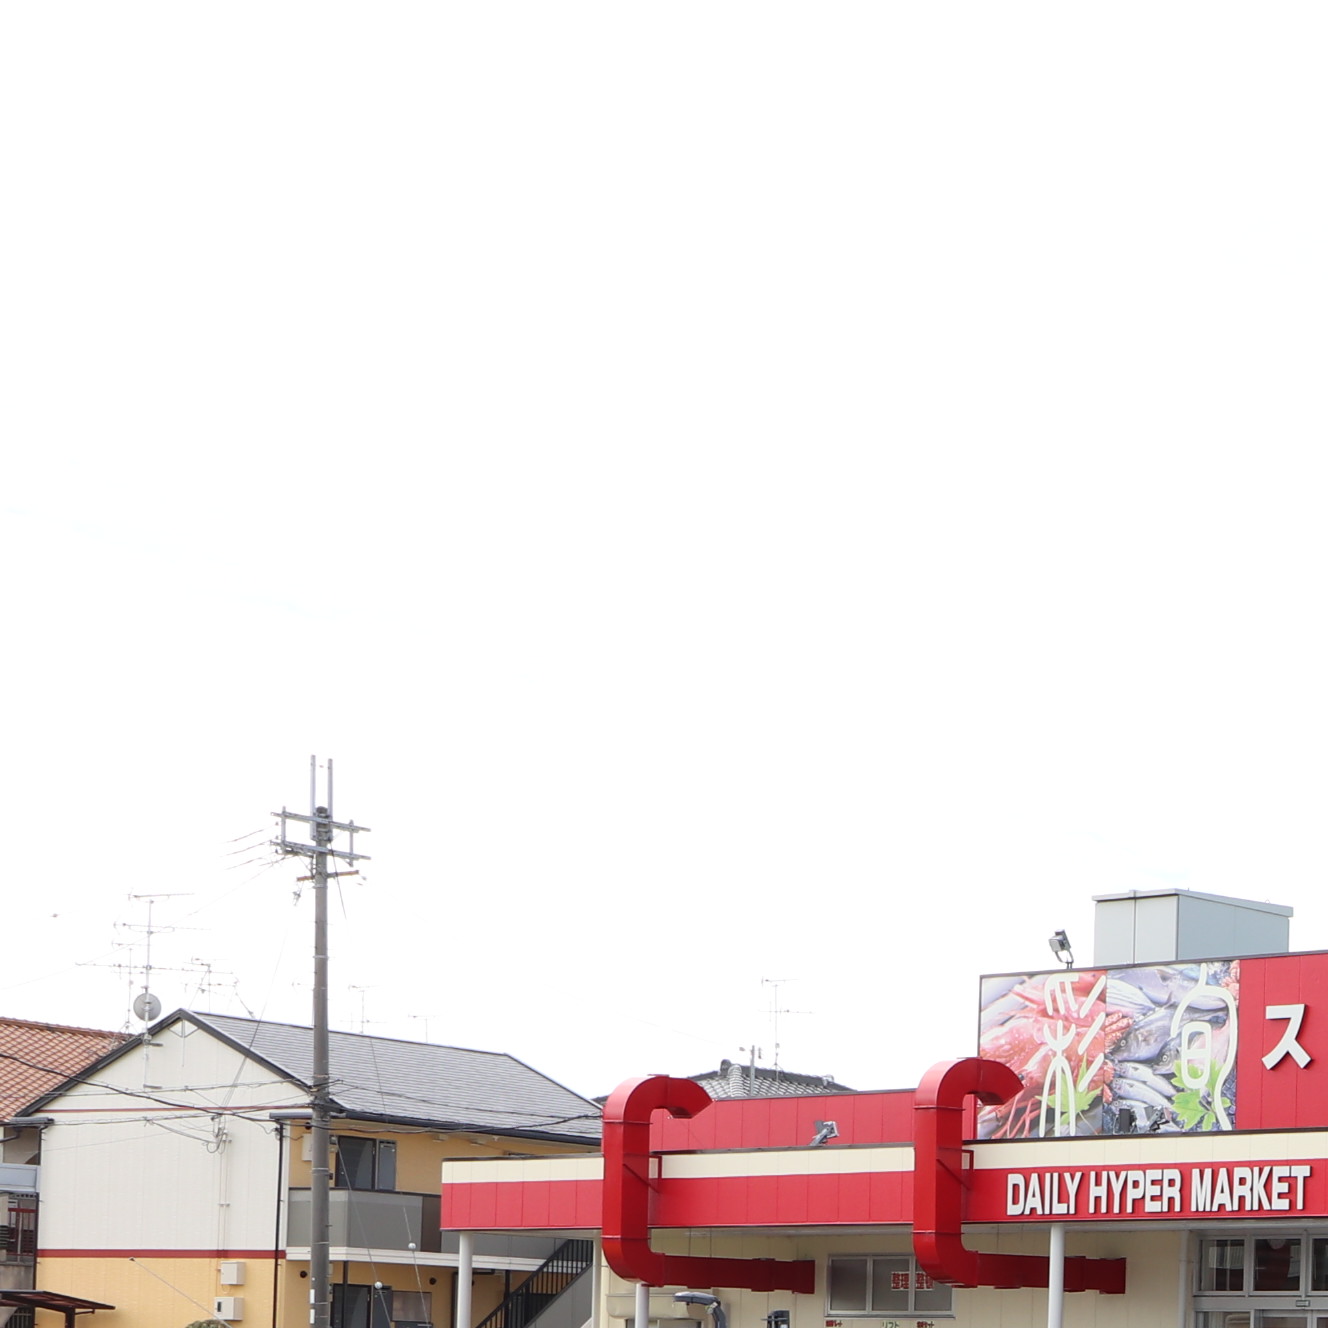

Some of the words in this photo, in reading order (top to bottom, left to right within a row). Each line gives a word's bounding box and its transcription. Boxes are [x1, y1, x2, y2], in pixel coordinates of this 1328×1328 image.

[1006, 1171, 1083, 1216] DAILY
[1089, 1168, 1182, 1214] HYPER
[1190, 1165, 1312, 1212] MARKET
